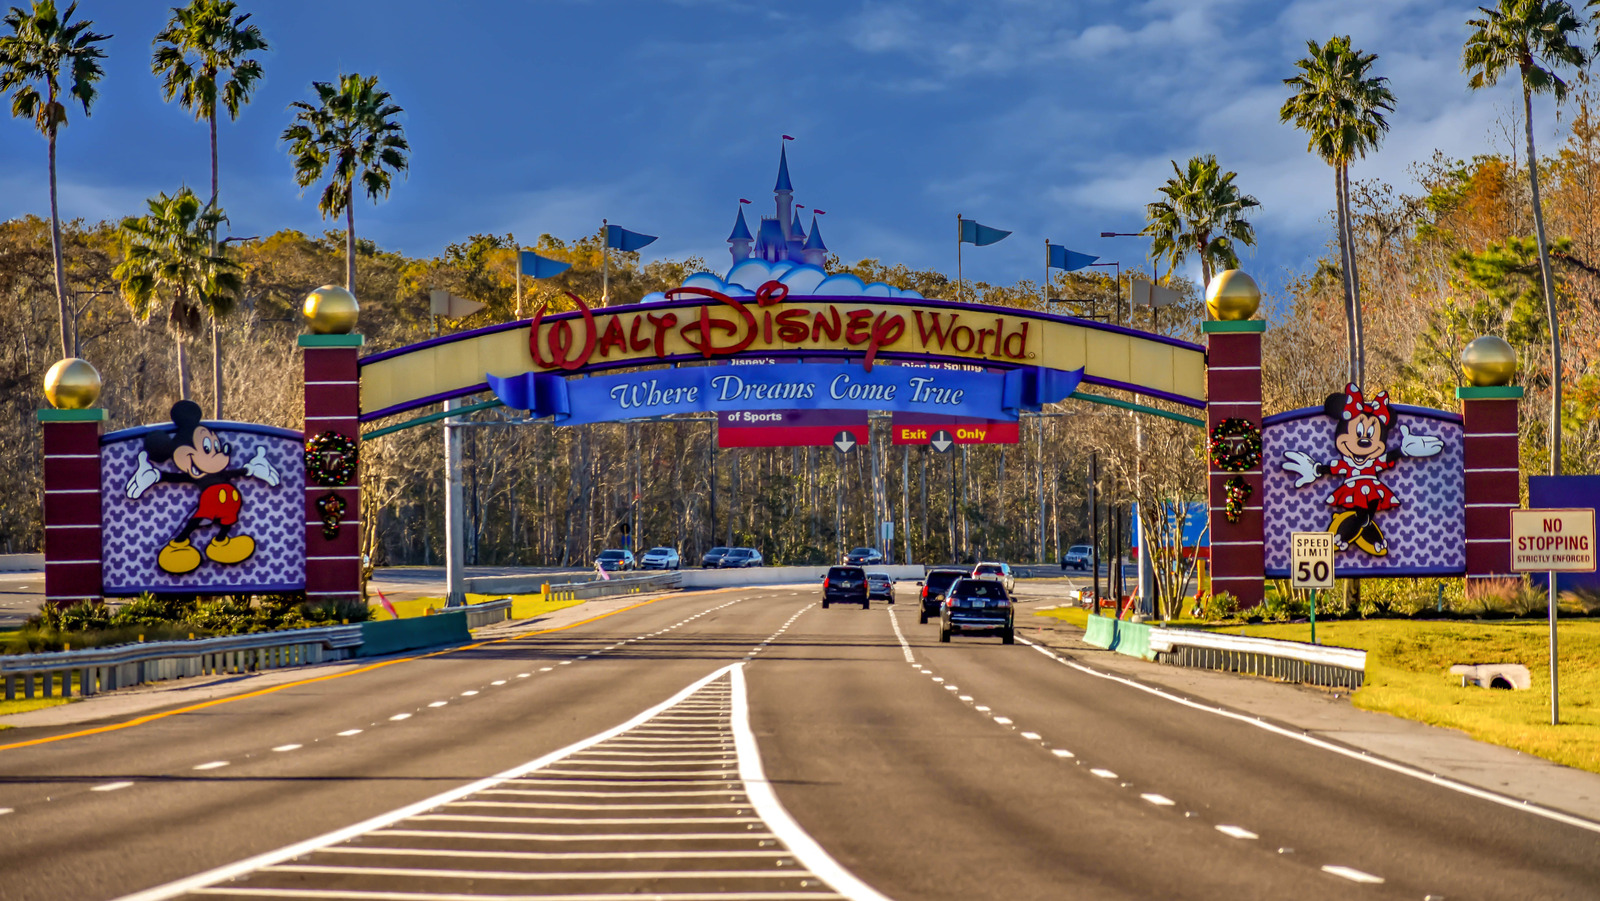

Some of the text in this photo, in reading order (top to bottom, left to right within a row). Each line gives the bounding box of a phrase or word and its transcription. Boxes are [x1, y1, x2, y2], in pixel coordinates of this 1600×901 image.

[912, 310, 1030, 359] World
[610, 373, 964, 409] Where Dreams Come True
[728, 412, 782, 423] of Sports
[902, 429, 986, 441] Exit Only
[1543, 518, 1562, 533] NO
[1297, 538, 1329, 547] SPEED
[1518, 535, 1589, 551] STOPPING
[1297, 548, 1328, 557] LIMIT
[1517, 554, 1590, 563] STRICTLY ENFORCED
[1297, 560, 1329, 582] 50
